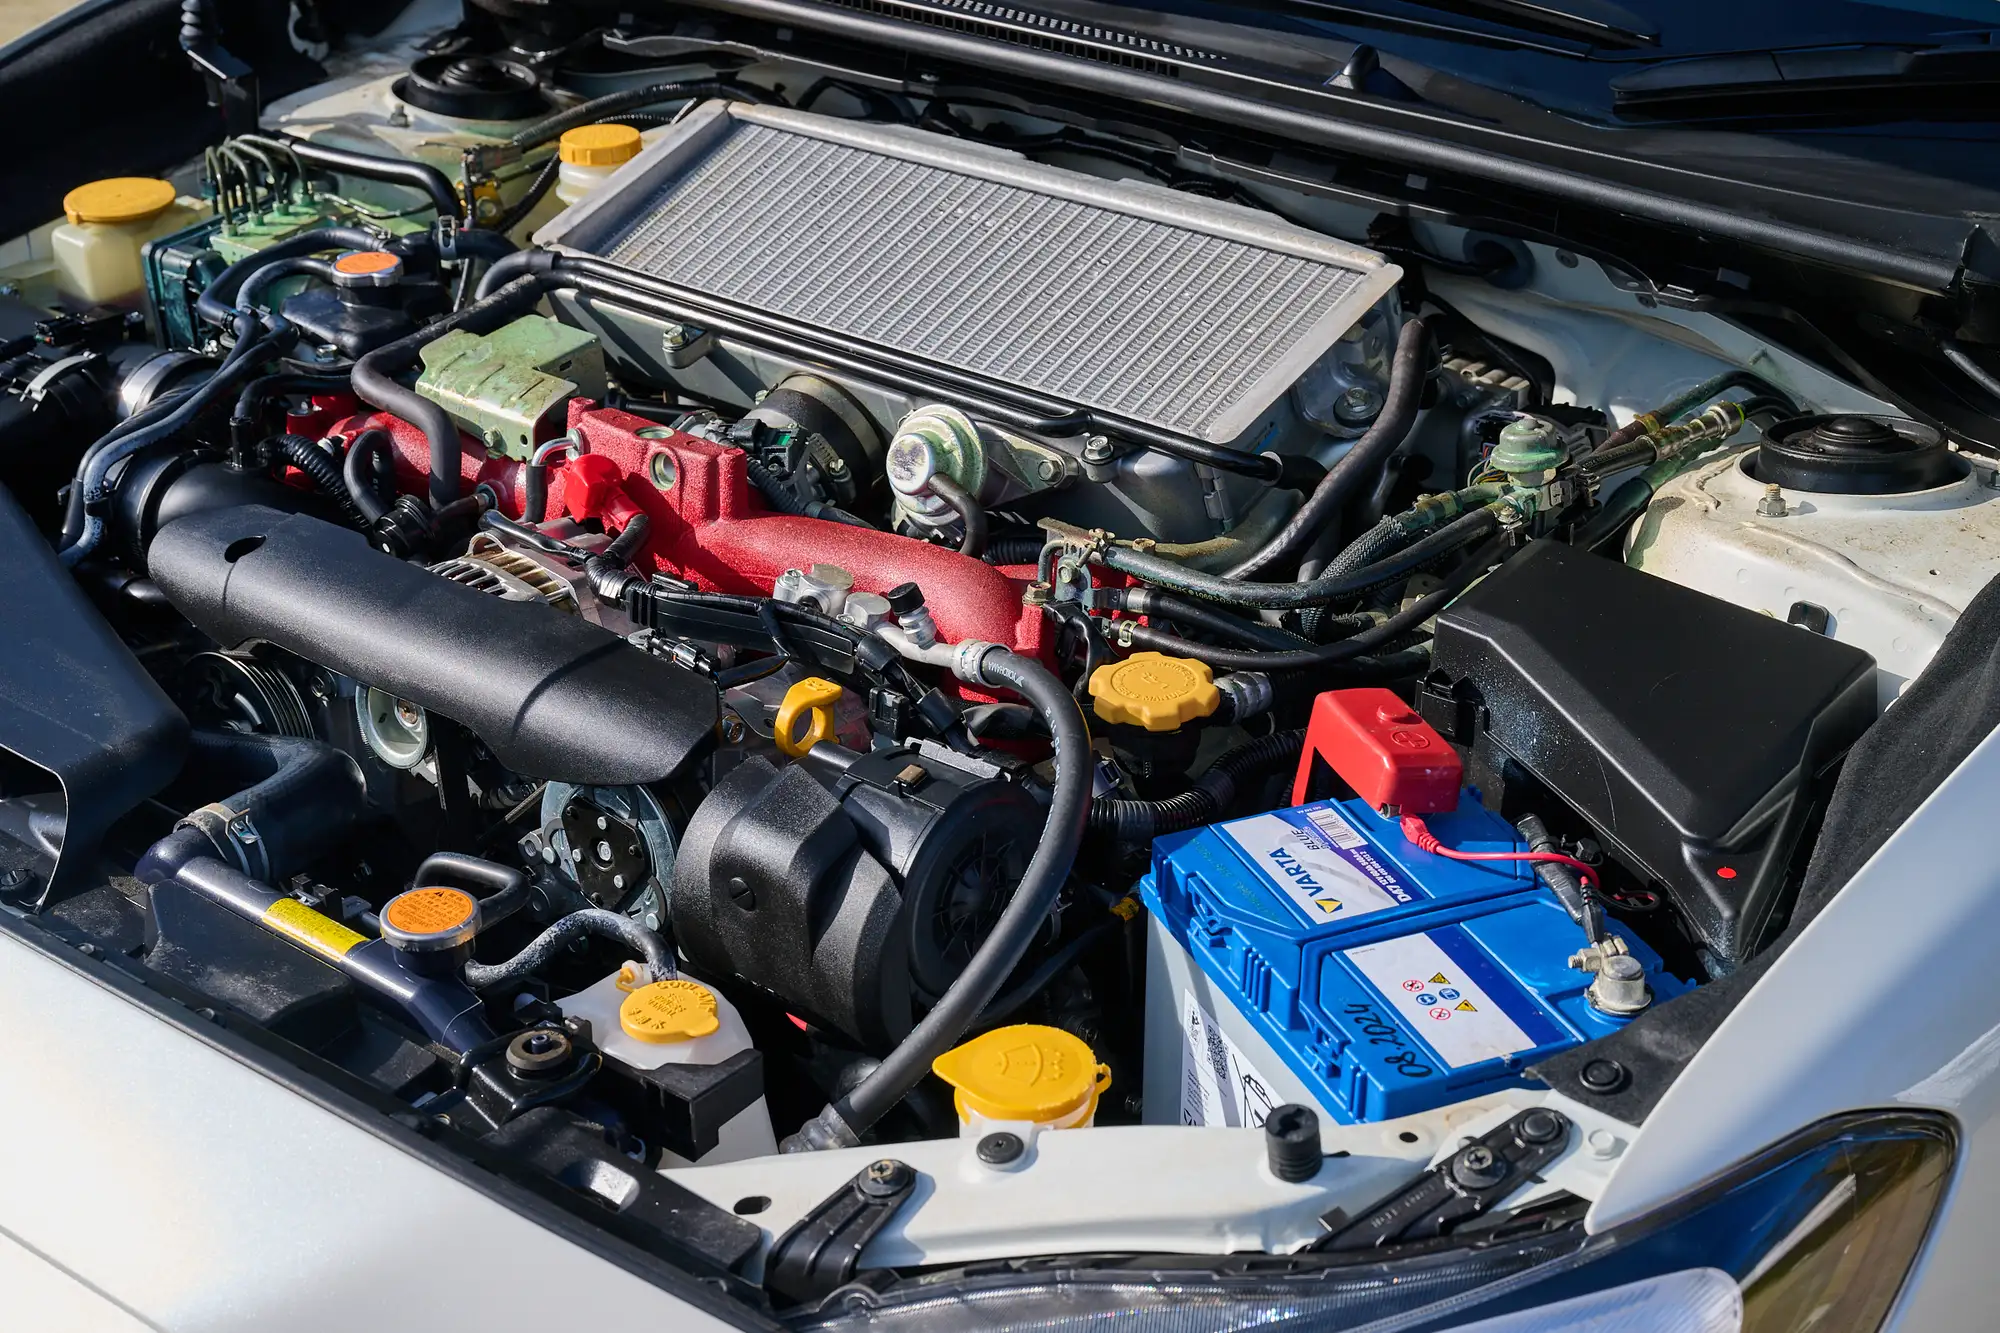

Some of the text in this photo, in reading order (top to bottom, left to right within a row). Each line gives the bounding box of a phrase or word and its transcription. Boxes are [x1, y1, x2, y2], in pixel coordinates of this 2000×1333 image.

[1291, 830, 1320, 850] BLUE
[1269, 847, 1324, 897] VARTA
[1385, 884, 1412, 903] D47
[656, 981, 716, 1013] COOLANT
[1344, 1004, 1433, 1077] 08.2024
